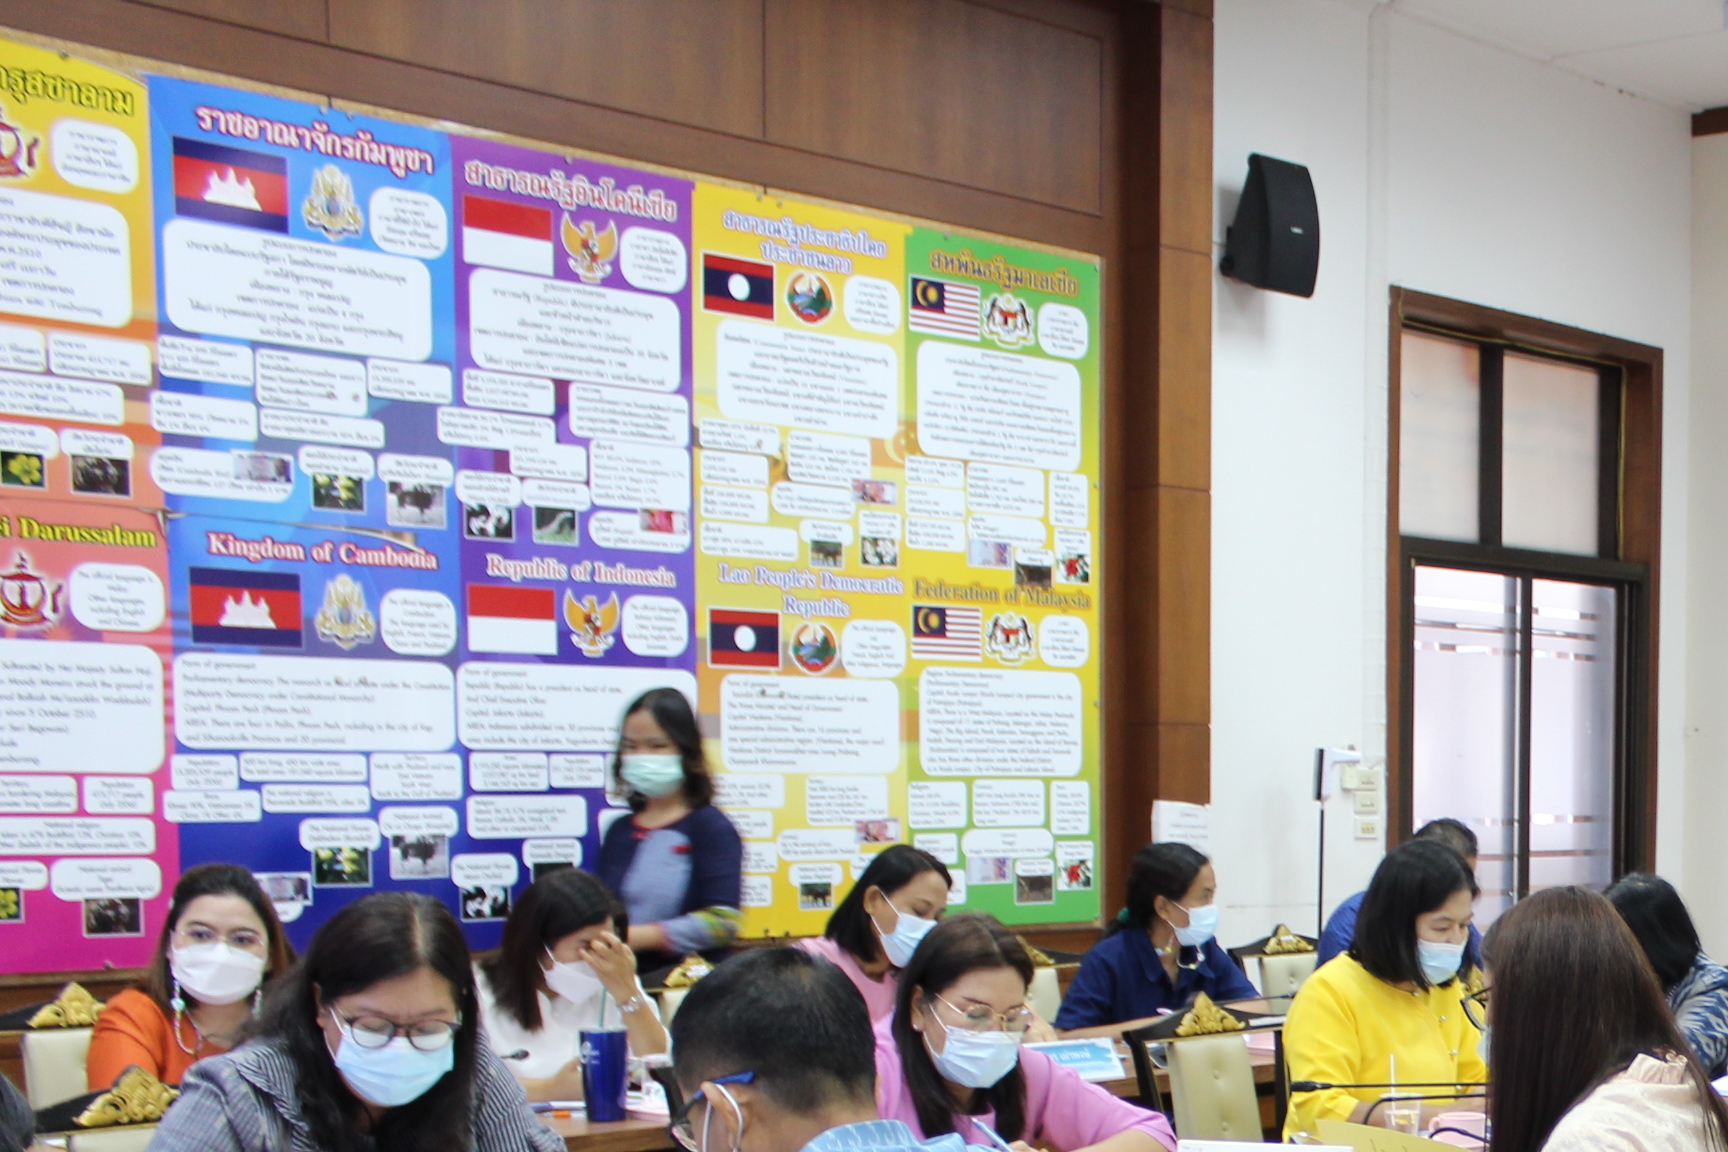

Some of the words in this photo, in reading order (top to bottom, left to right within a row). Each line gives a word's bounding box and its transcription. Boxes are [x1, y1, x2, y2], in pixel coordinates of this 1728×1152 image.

[195, 105, 434, 179] ราชอาณาจักรกัมพูชา
[18, 516, 157, 547] Darussalam
[207, 531, 306, 562] Kingdom
[311, 540, 335, 563] of
[339, 543, 439, 571] Cambodia
[486, 553, 568, 582] Republic
[570, 560, 592, 582] of
[593, 561, 677, 588] Indonesia
[718, 562, 751, 584] Lao
[754, 564, 816, 590] People's
[819, 570, 905, 594] Democratic
[782, 594, 850, 618] Republic
[912, 577, 999, 603] Federation
[1004, 584, 1019, 603] of
[1020, 585, 1092, 613] Malaysia
